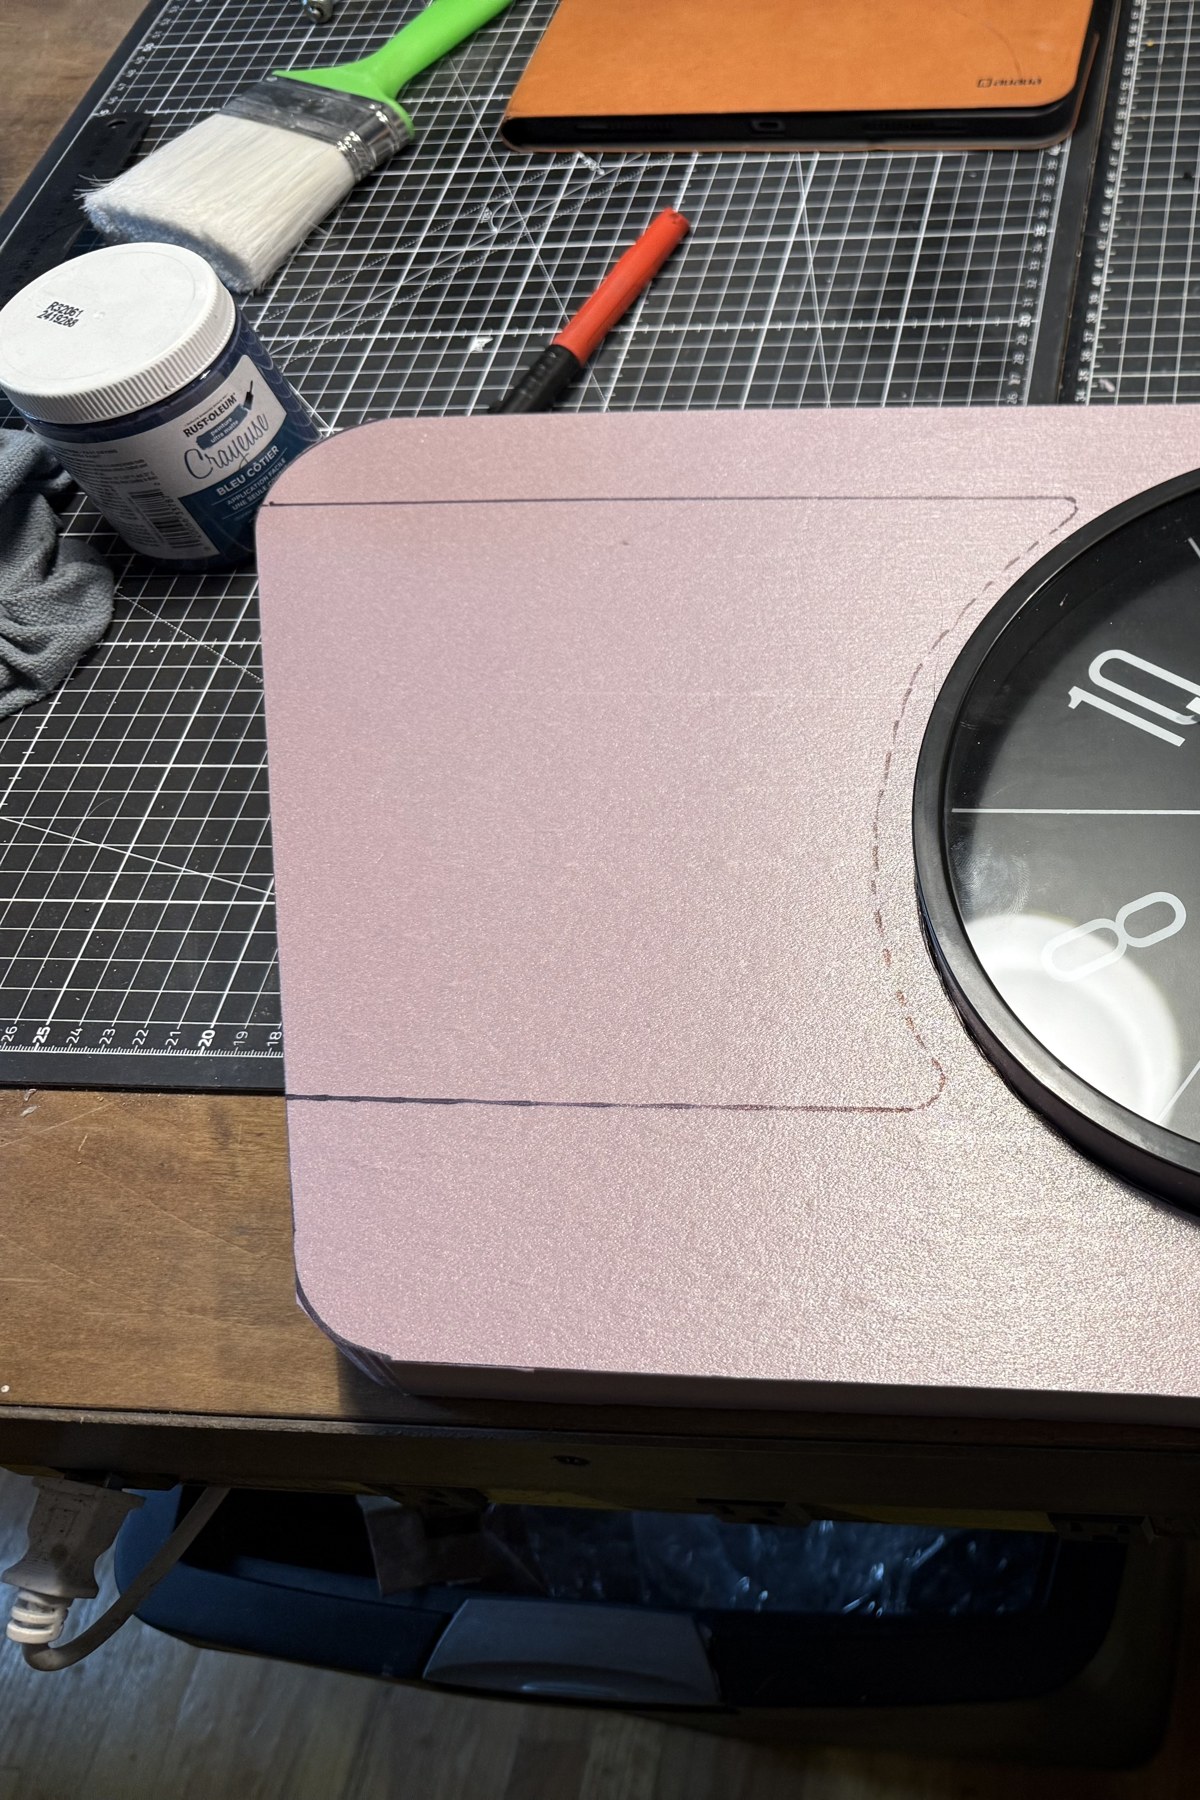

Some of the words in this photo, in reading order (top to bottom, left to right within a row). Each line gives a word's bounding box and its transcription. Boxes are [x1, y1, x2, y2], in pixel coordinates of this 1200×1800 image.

[46, 301, 84, 318] R32061
[1018, 313, 1031, 327] 30
[1083, 329, 1094, 342] 37
[1077, 368, 1090, 382] 35
[1007, 391, 1018, 404] 26
[1075, 388, 1086, 402] 34
[183, 393, 238, 438] RUST-OLEUM
[210, 417, 233, 437] peinture
[210, 431, 225, 443] ultra
[223, 420, 239, 436] matte
[184, 413, 270, 480] Crayeuse
[216, 474, 247, 496] BLEU
[227, 475, 269, 506] APPLICATION
[267, 457, 287, 478] FACILE
[232, 500, 247, 511] UNE
[247, 484, 268, 502] SEULE
[1039, 890, 1188, 983] 8
[0, 1026, 18, 1042] 26
[32, 1026, 51, 1044] 25
[66, 1028, 83, 1044] 24
[99, 1028, 116, 1045] 23
[132, 1029, 149, 1045] 22
[165, 1031, 181, 1046] 21
[197, 1029, 216, 1047] 20
[233, 1031, 248, 1046] 19
[267, 1031, 282, 1046] 18
